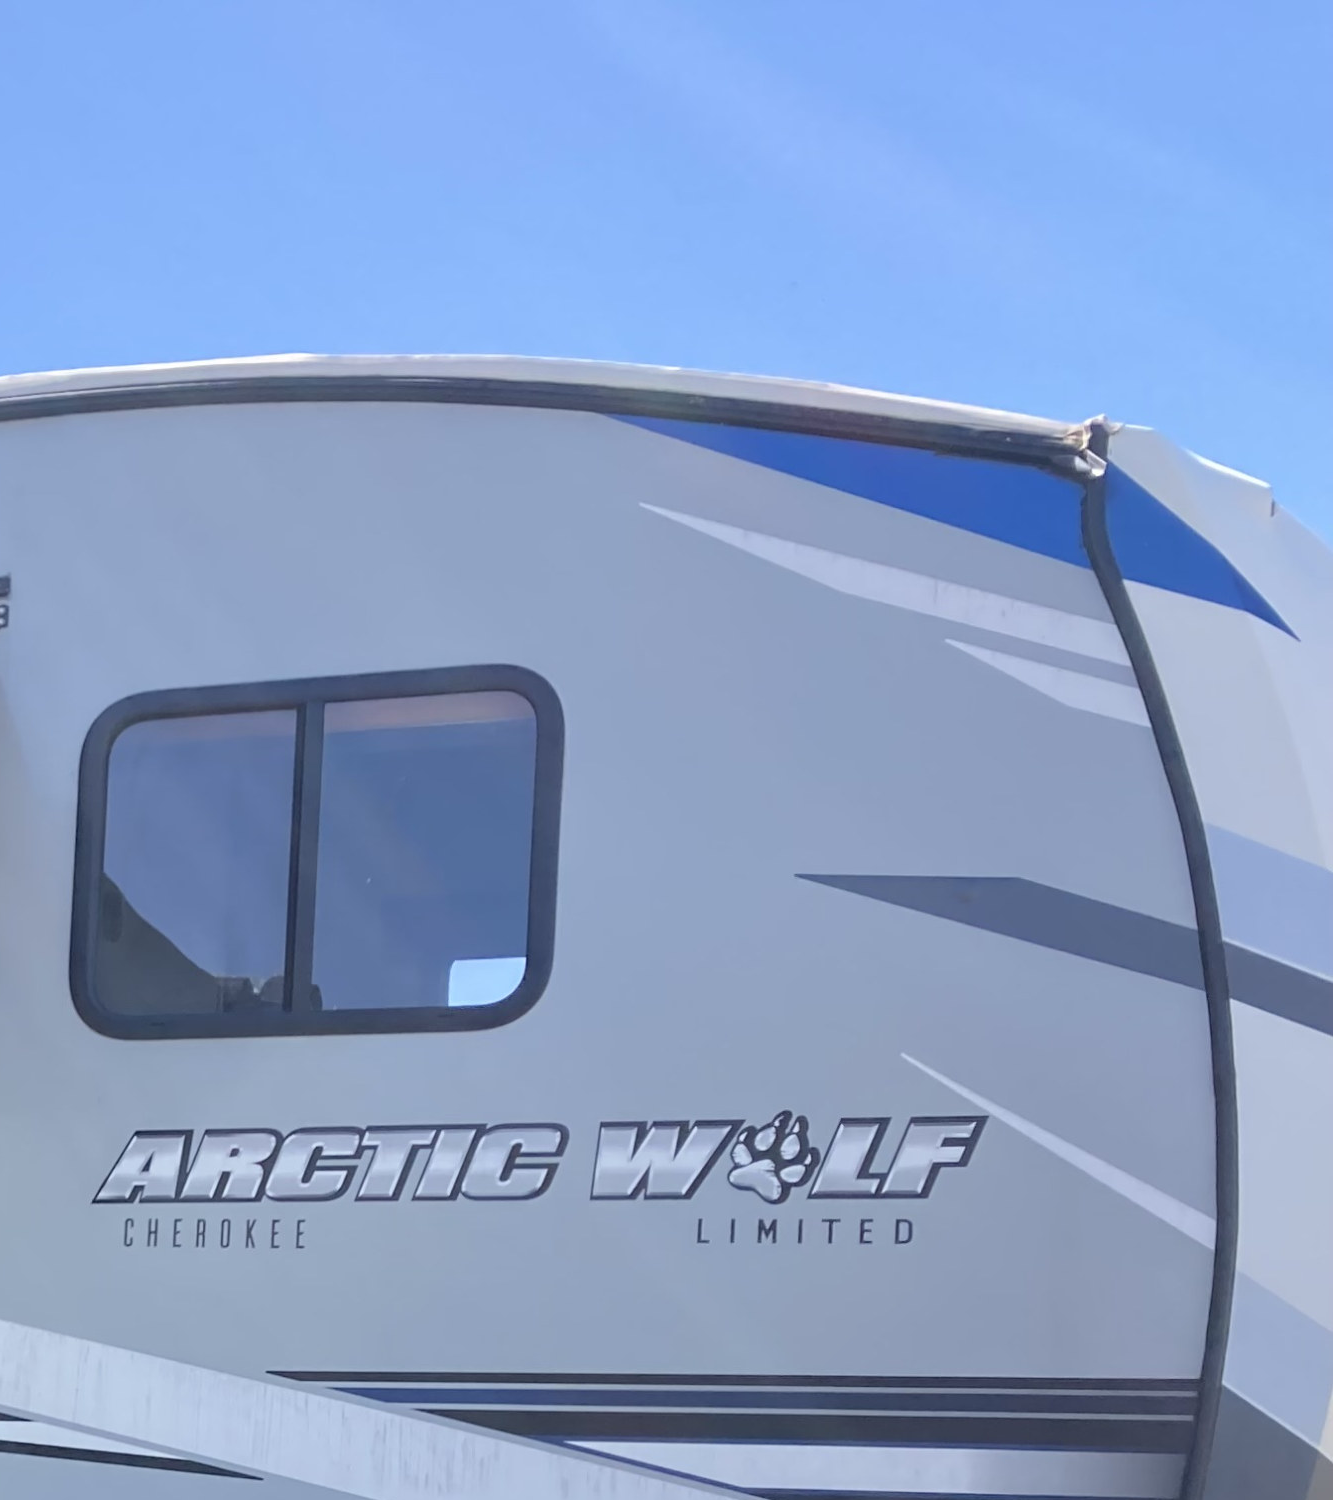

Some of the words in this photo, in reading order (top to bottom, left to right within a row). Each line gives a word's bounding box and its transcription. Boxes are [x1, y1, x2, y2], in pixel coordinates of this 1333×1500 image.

[93, 1123, 569, 1204] ARCTIC
[123, 1217, 308, 1249] CHEROKEE
[695, 1218, 917, 1246] LIMITED
